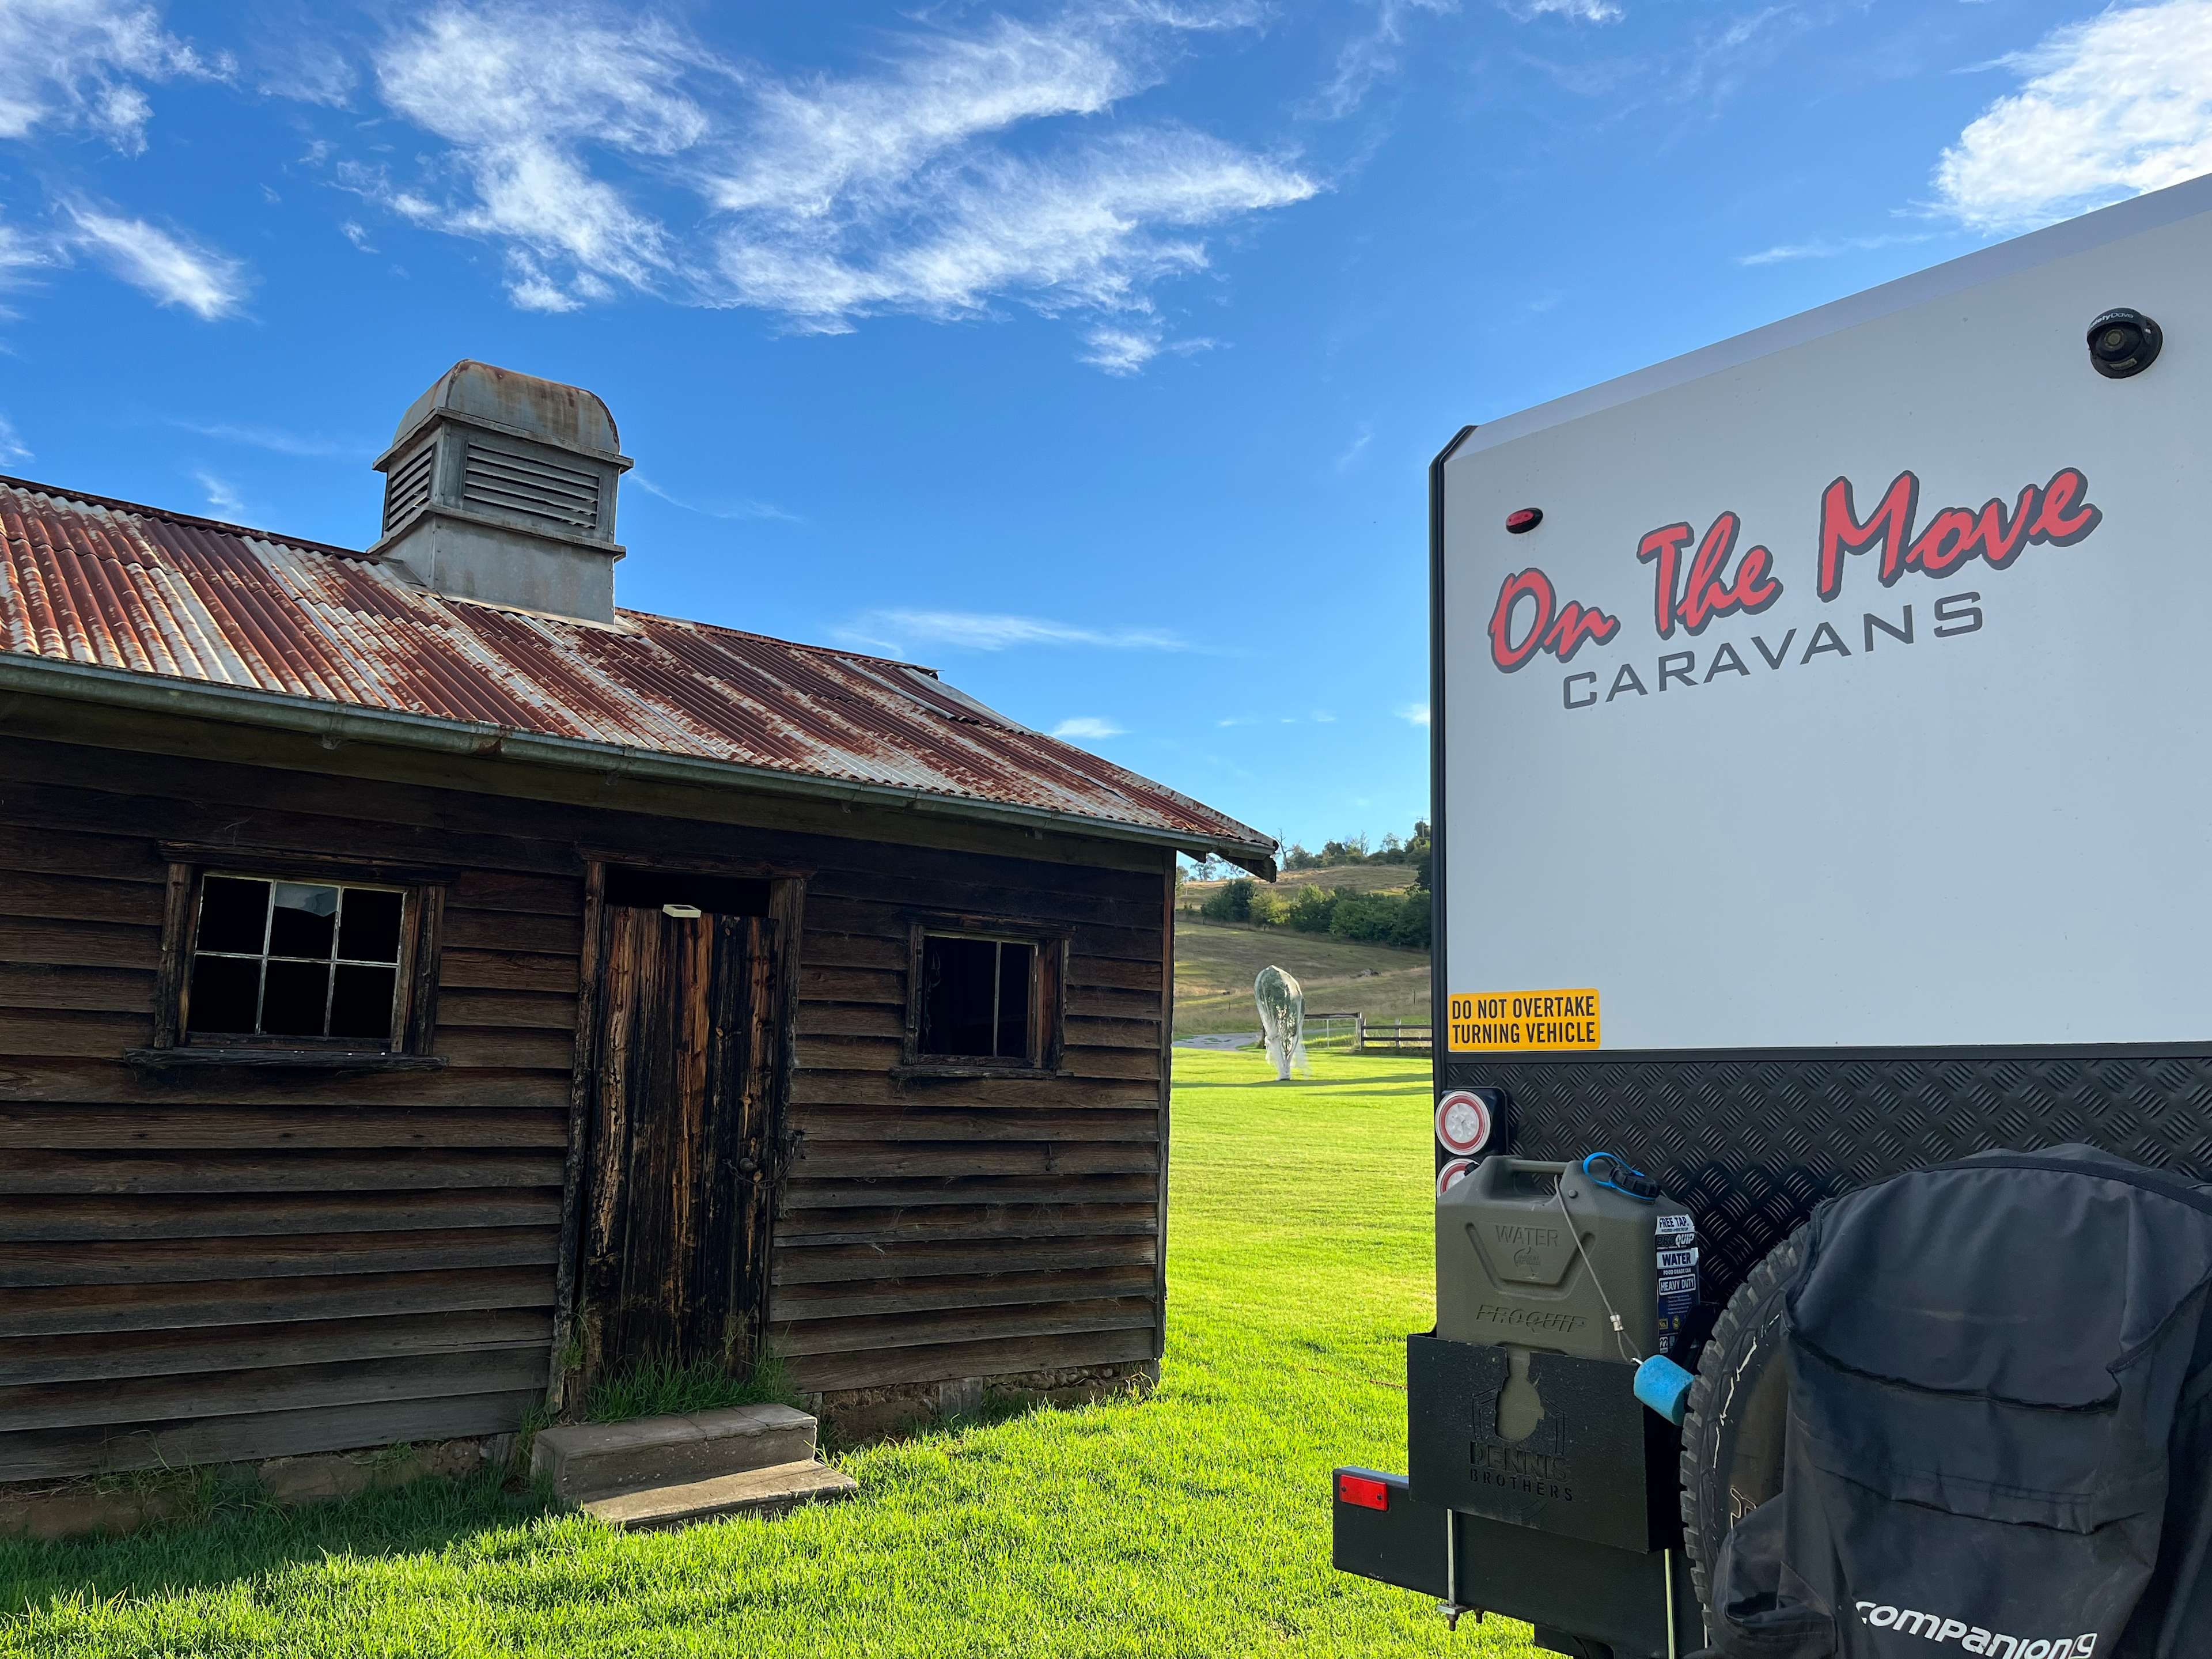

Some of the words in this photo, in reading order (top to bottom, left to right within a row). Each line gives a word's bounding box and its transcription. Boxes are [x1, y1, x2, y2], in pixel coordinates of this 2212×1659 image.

[1488, 567, 1620, 673] On
[1637, 511, 1783, 639] The
[1817, 467, 2103, 602] Move
[1563, 592, 1983, 710] CARAVANS
[1452, 1000, 1471, 1020] DO
[1478, 999, 1507, 1019] NOT
[1513, 996, 1595, 1018] OVERTAKE
[1452, 1023, 1520, 1044] TURNING
[1526, 1022, 1595, 1043] VEHICLE
[1659, 1217, 1675, 1228] FREE
[1675, 1217, 1689, 1226] TAP.
[1495, 1225, 1558, 1247] WATER
[1662, 1252, 1691, 1266] WATER
[1660, 1280, 1680, 1291] HEAVY
[1681, 1278, 1694, 1289] DUTY
[1476, 1305, 1589, 1334] PROQUIP
[1471, 1469, 1573, 1501] BROTHERS
